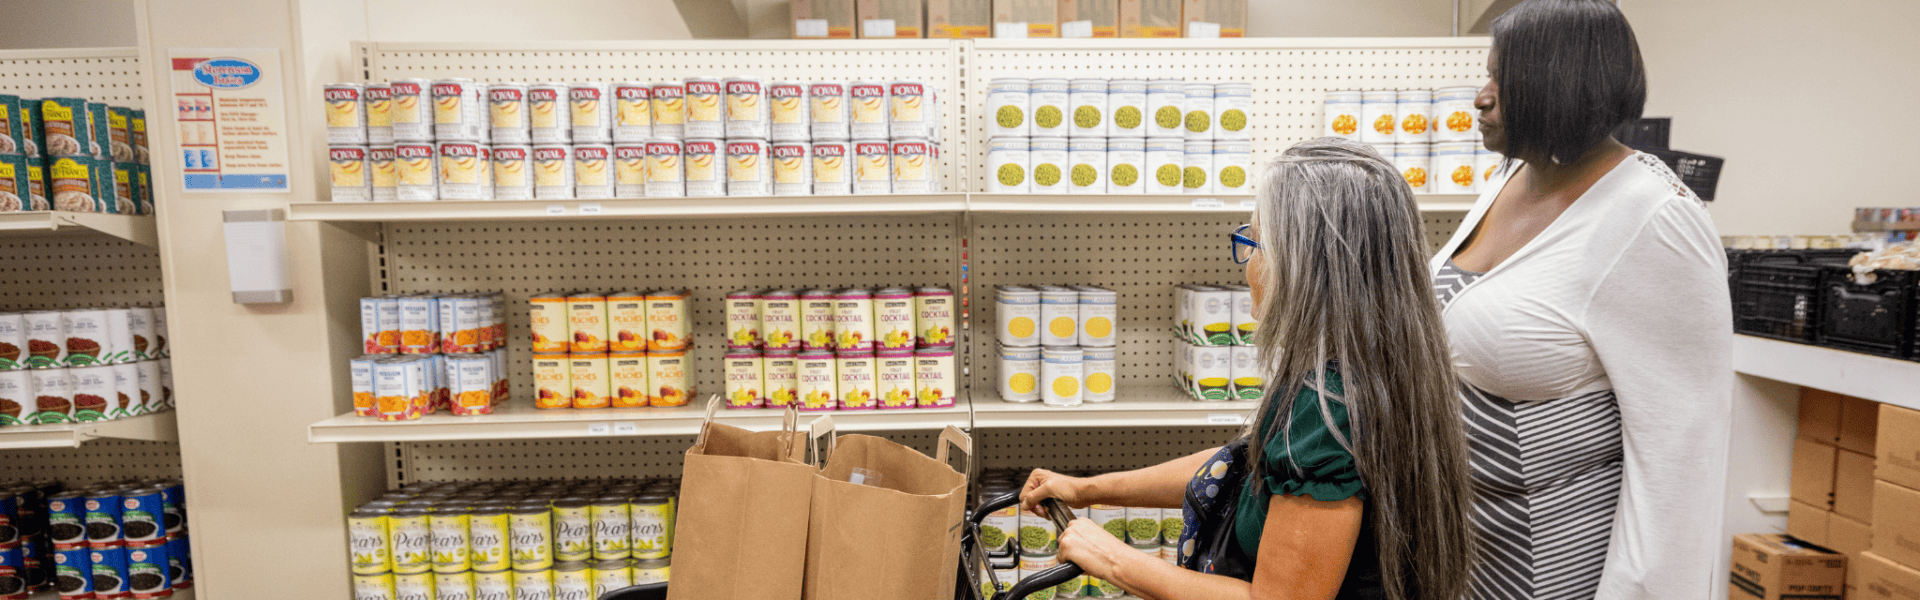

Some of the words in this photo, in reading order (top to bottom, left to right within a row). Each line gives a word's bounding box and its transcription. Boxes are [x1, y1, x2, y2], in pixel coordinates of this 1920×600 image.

[688, 83, 717, 95] ROYAL
[728, 84, 757, 95] ROYAL
[771, 87, 799, 99] ROYAL
[813, 86, 841, 97] ROYAL
[854, 88, 881, 98] ROYAL
[894, 86, 921, 97] ROYAL
[399, 147, 428, 158] ROYAL
[444, 146, 474, 157] ROYAL
[494, 149, 521, 160] ROYAL
[576, 149, 604, 160] ROYAL
[648, 144, 677, 156] ROYAL
[728, 144, 757, 155] ROYAL
[773, 147, 801, 158] ROYAL
[814, 147, 841, 158] ROYAL
[859, 144, 887, 155] ROYAL
[897, 144, 924, 155] ROYAL
[730, 313, 758, 321] COCKTAIL
[880, 314, 910, 322] COCKTAIL
[921, 310, 950, 318] COCKTAIL
[728, 373, 757, 381] COCKTAIL
[768, 372, 797, 380] COCKTAIL
[801, 374, 831, 382] COCKTAIL
[841, 373, 871, 381] COCKTAIL
